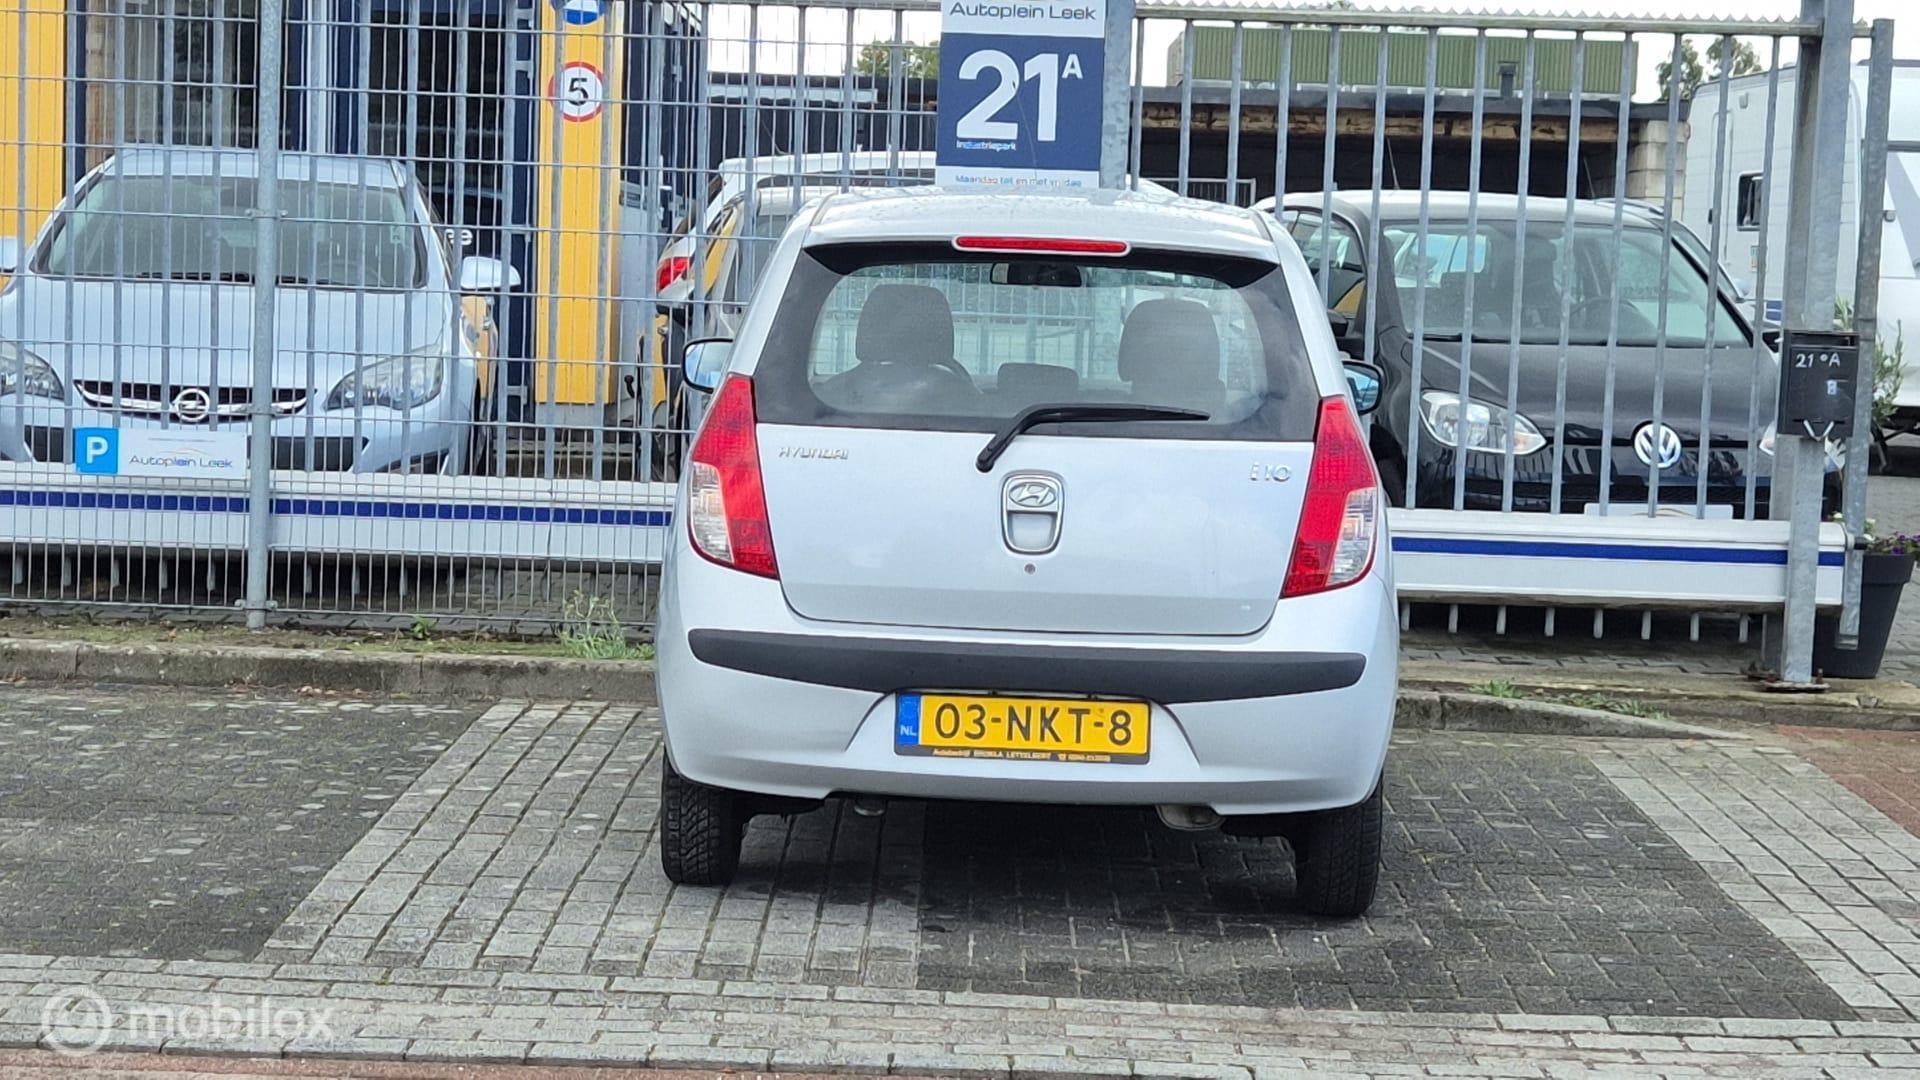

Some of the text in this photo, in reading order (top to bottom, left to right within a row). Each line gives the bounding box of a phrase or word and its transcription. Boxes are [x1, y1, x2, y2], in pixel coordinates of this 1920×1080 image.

[950, 2, 1097, 21] Autoplein Leek
[568, 77, 589, 106] 5
[956, 140, 1016, 152] Industriepark
[86, 436, 109, 464] P
[778, 446, 849, 460] HYUNDAI
[129, 455, 233, 468] Autoplein Leek
[900, 723, 918, 737] NL
[934, 702, 1133, 746] 03-NKT-8
